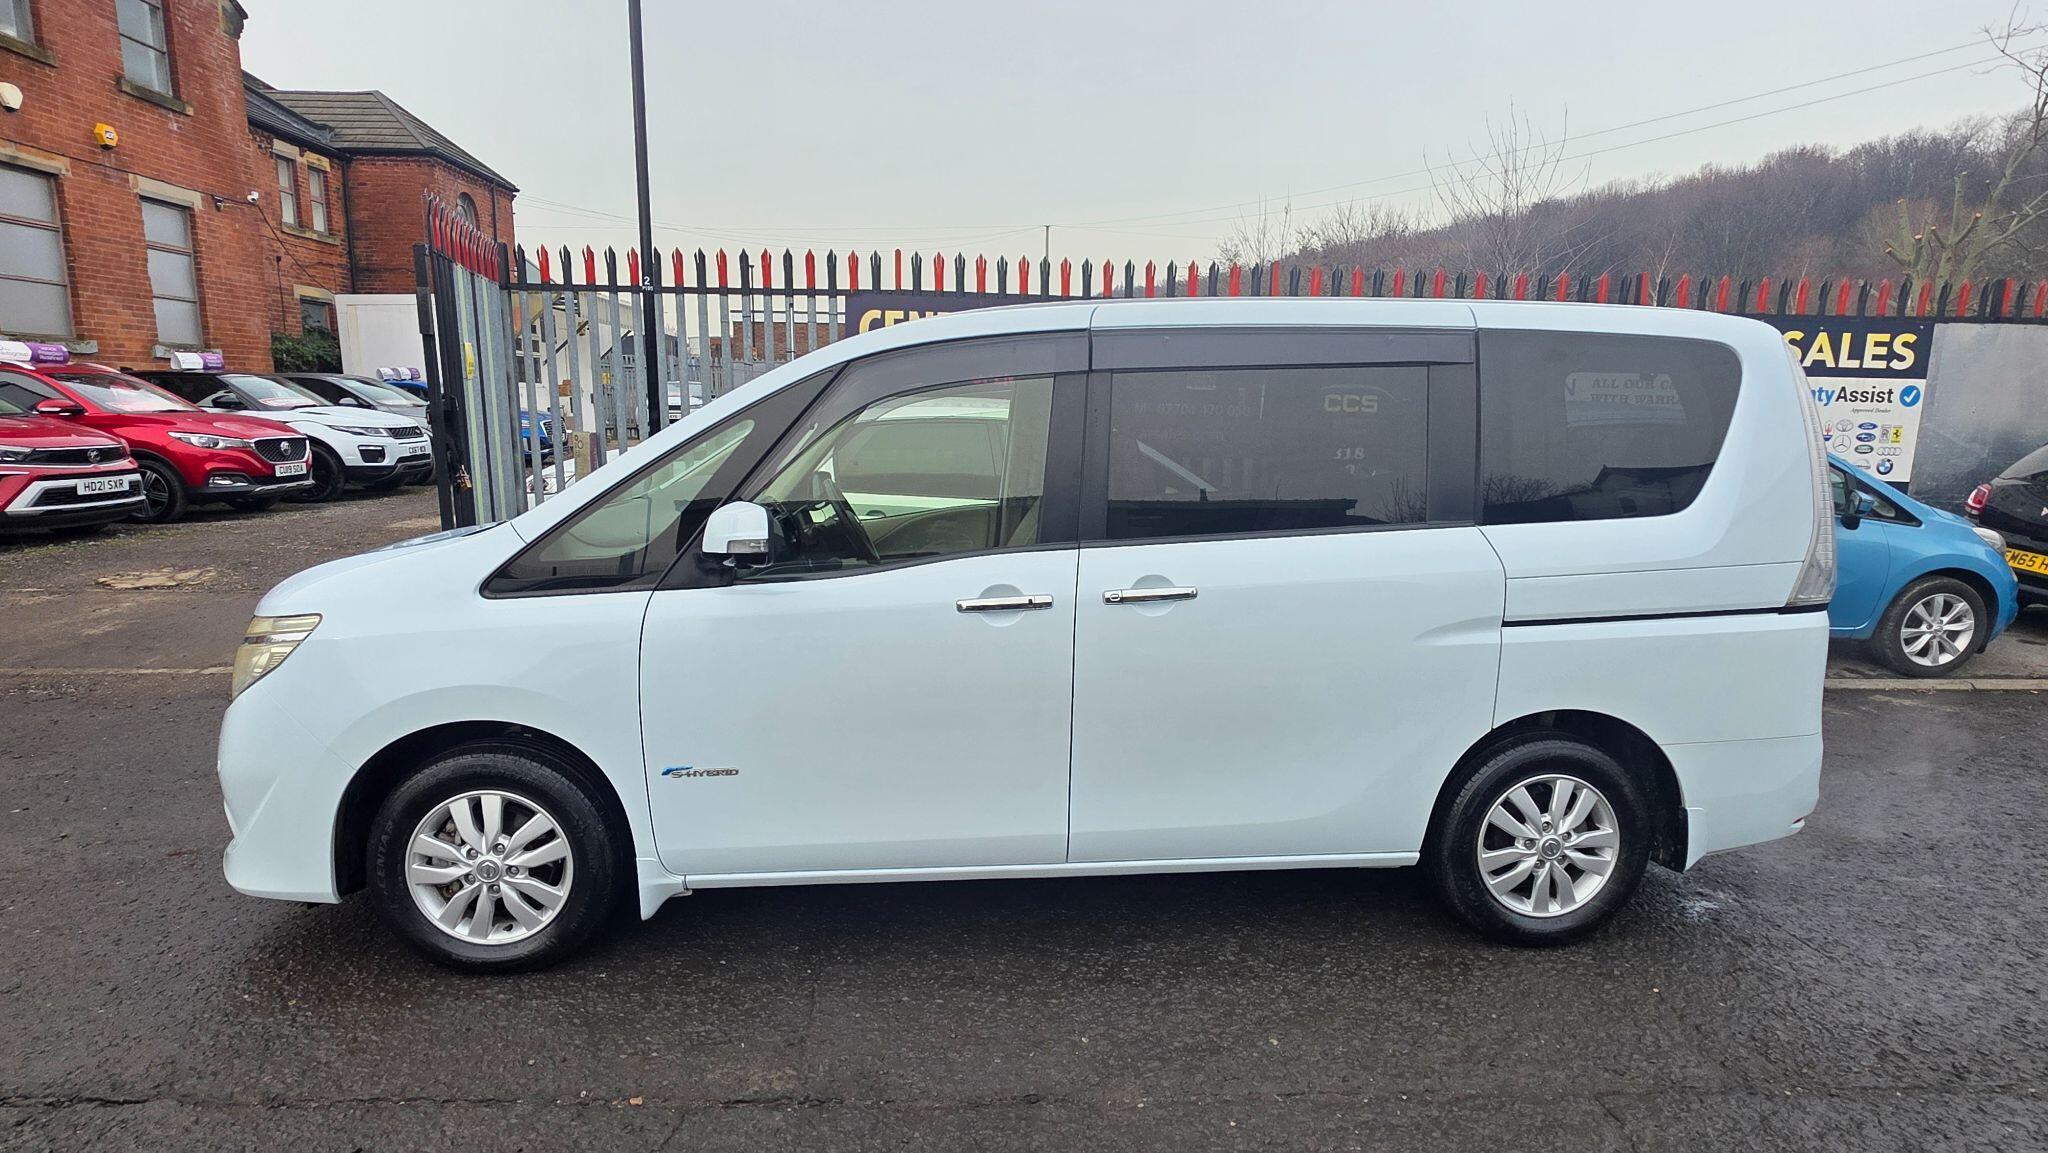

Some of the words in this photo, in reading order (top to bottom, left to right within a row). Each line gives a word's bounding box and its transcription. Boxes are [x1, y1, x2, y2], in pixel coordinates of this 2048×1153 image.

[643, 276, 651, 285] 2
[1324, 394, 1379, 413] CCS
[83, 480, 106, 492] HD21
[107, 478, 126, 490] SXR
[671, 768, 739, 778] S-HYBRID
